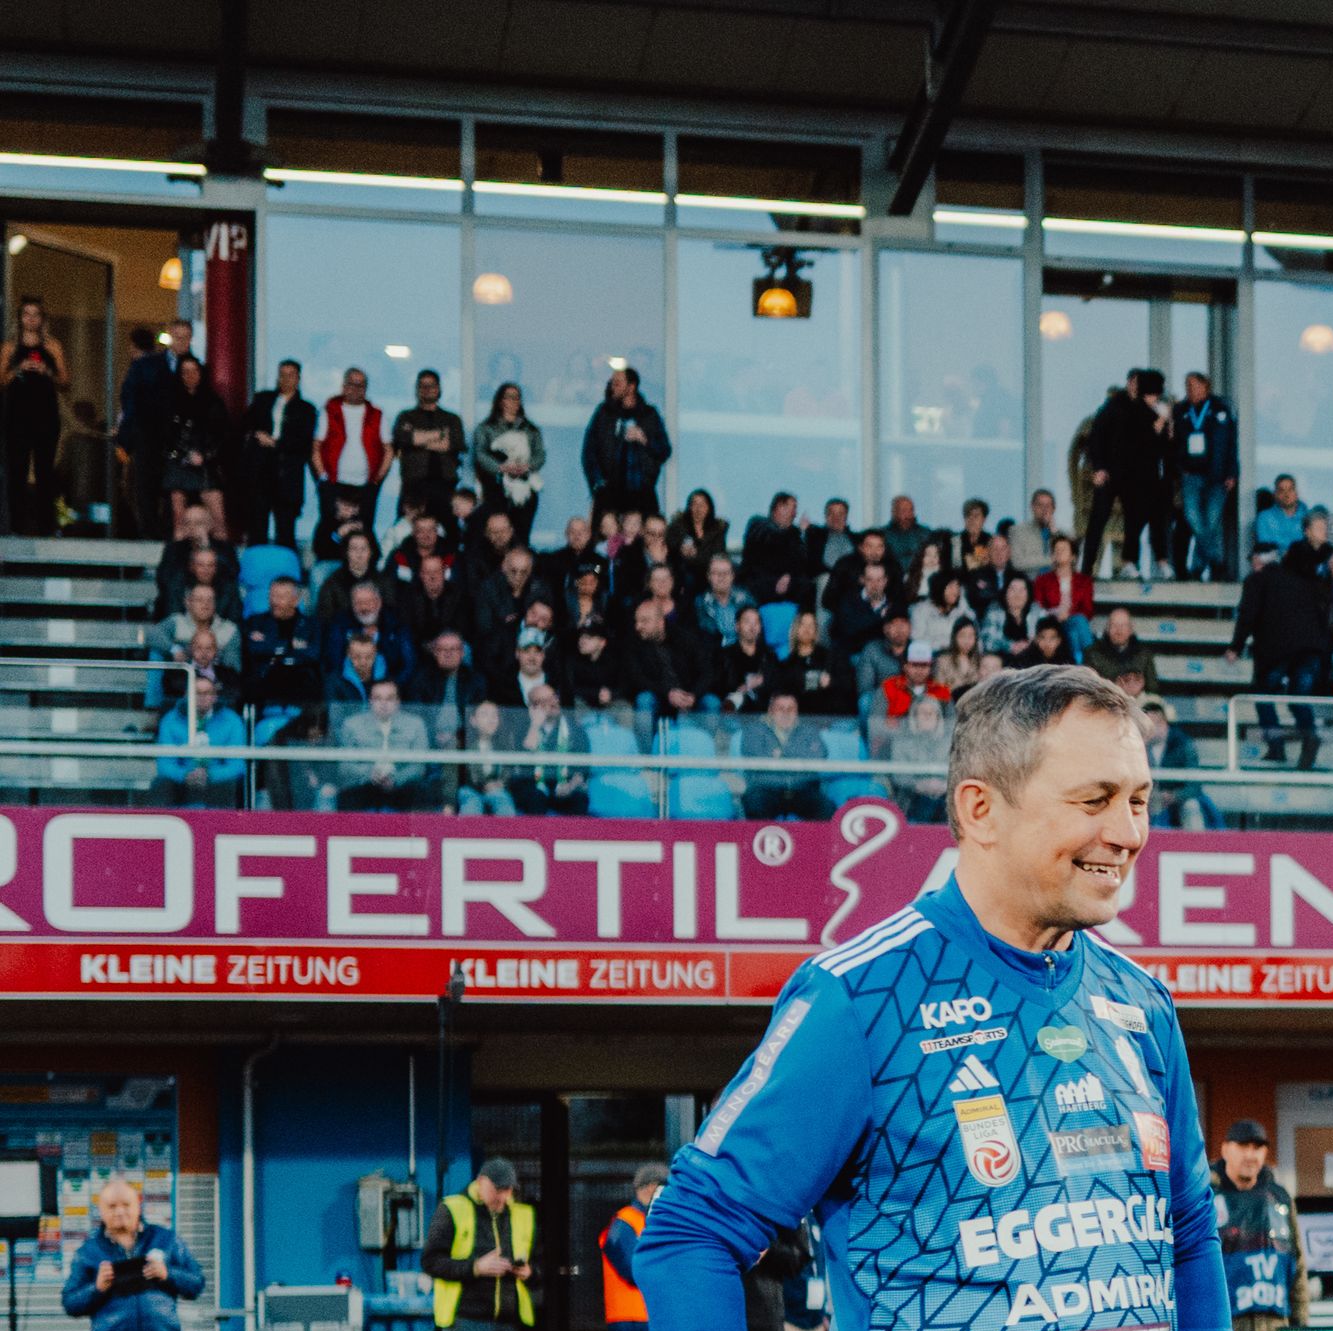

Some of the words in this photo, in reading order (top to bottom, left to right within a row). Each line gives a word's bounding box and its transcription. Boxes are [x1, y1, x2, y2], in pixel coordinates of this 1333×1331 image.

[80, 953, 216, 986] KLEINE
[226, 954, 360, 987] ZEITUNG
[588, 958, 715, 991] ZEITUNG
[919, 996, 992, 1029] KAPO
[1058, 1101, 1108, 1114] HARTBERG
[963, 1117, 1006, 1133] BUNDES
[973, 1128, 998, 1140] LIGA
[1245, 1252, 1279, 1281] TV
